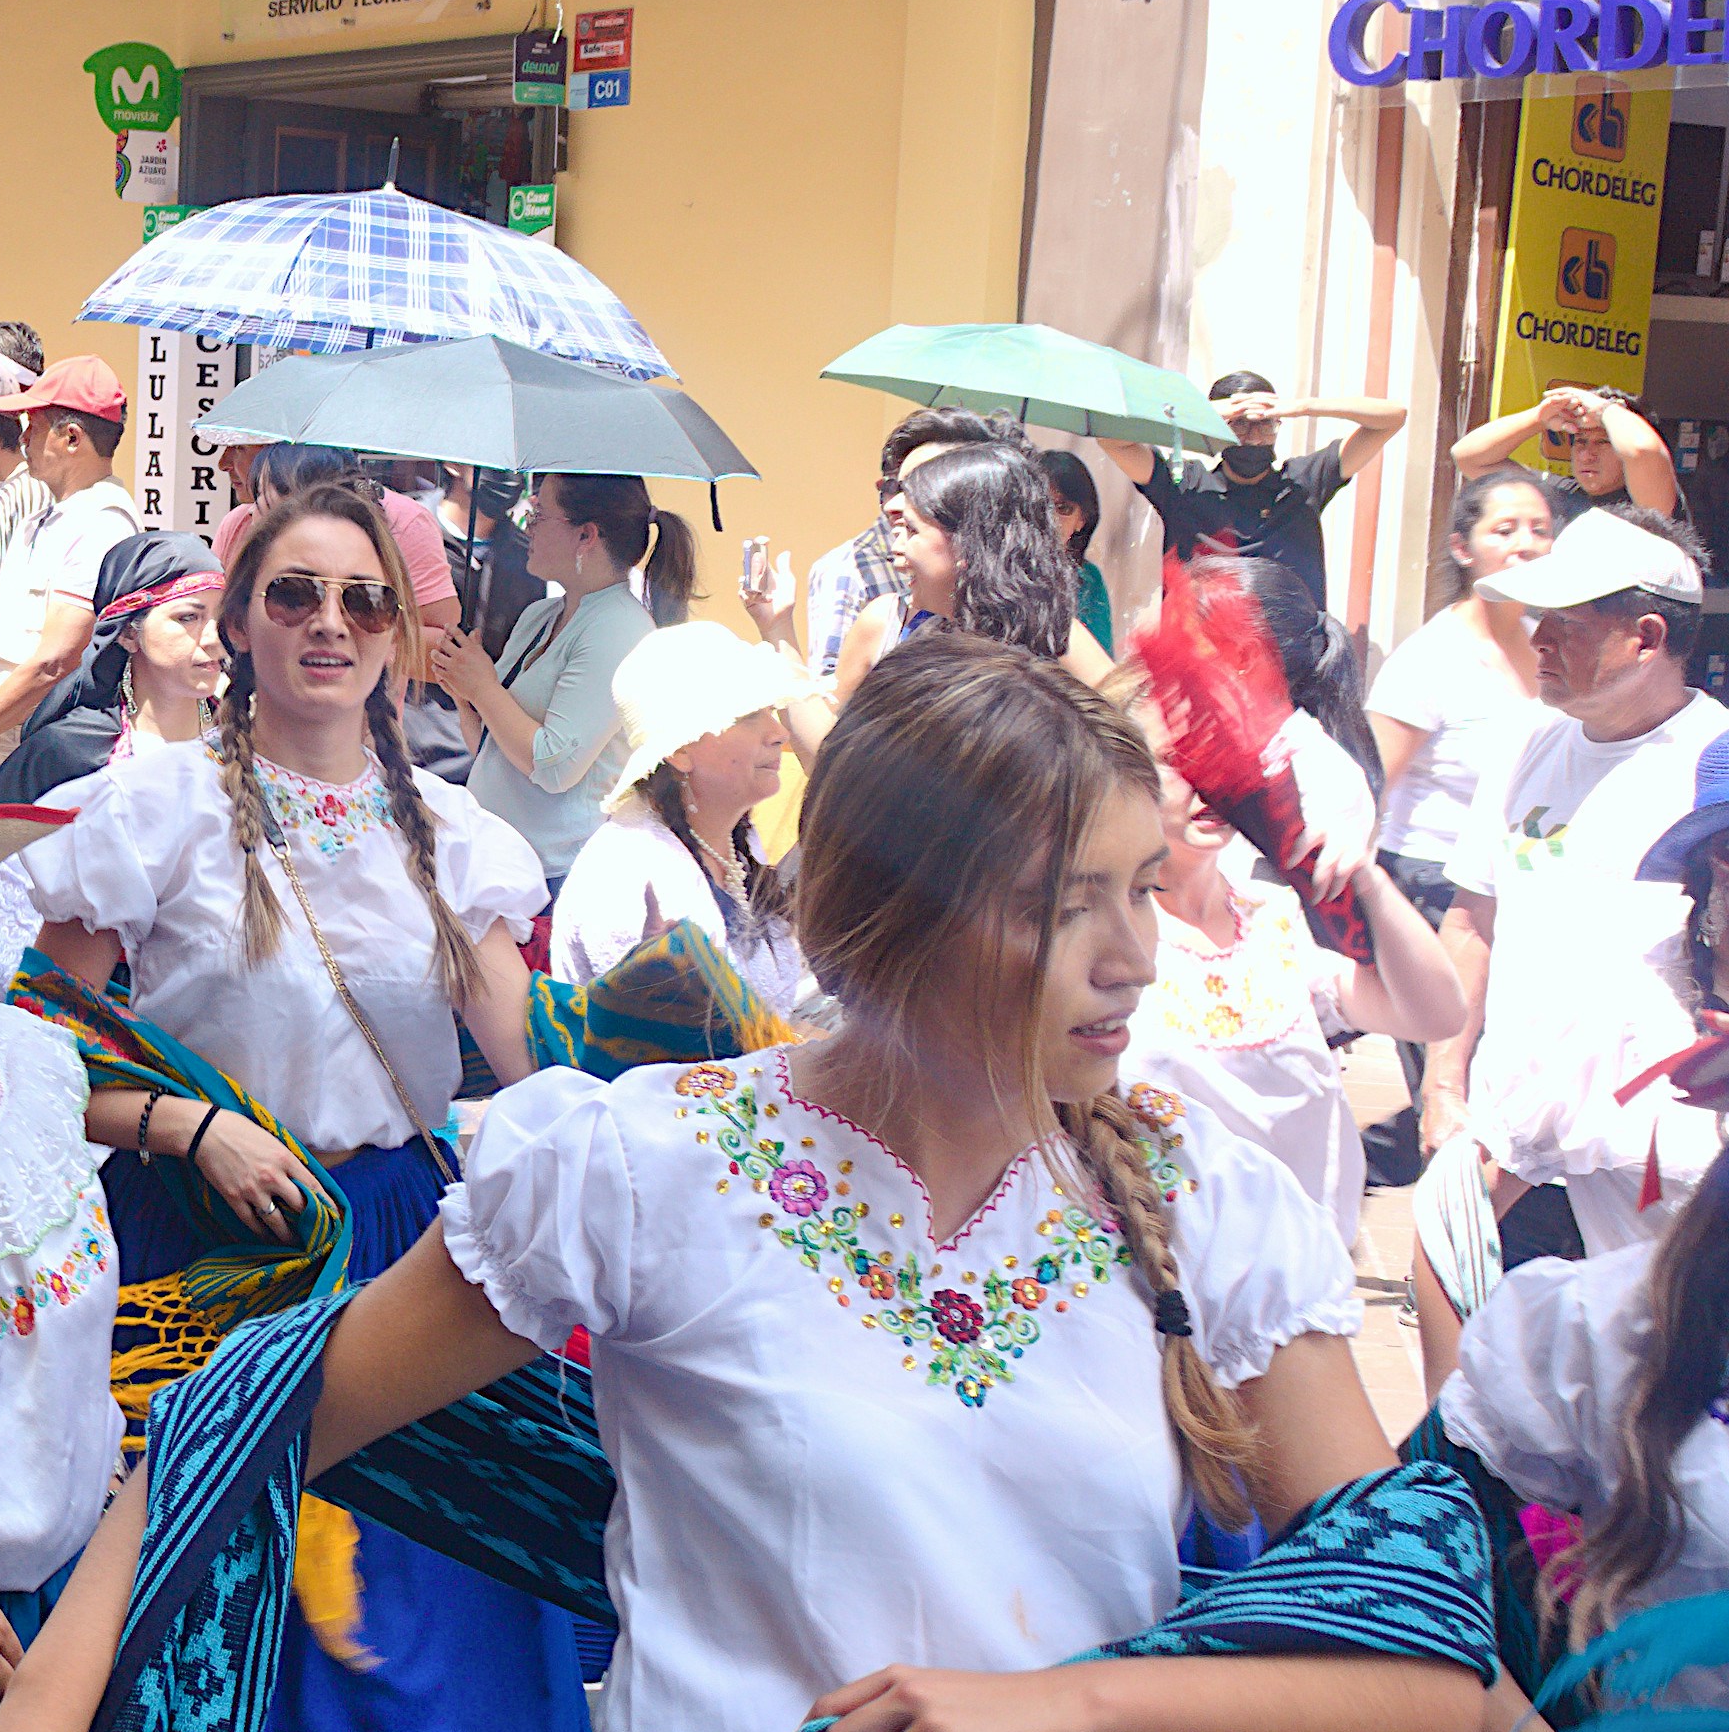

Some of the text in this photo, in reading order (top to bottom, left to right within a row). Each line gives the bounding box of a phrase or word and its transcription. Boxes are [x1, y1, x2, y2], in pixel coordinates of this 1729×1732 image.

[594, 79, 621, 100] C01
[113, 110, 160, 123] movistar
[1531, 157, 1657, 207] CHORDELEG
[526, 190, 550, 204] Case
[524, 204, 552, 217] Store
[1516, 311, 1643, 357] CHORDELEG
